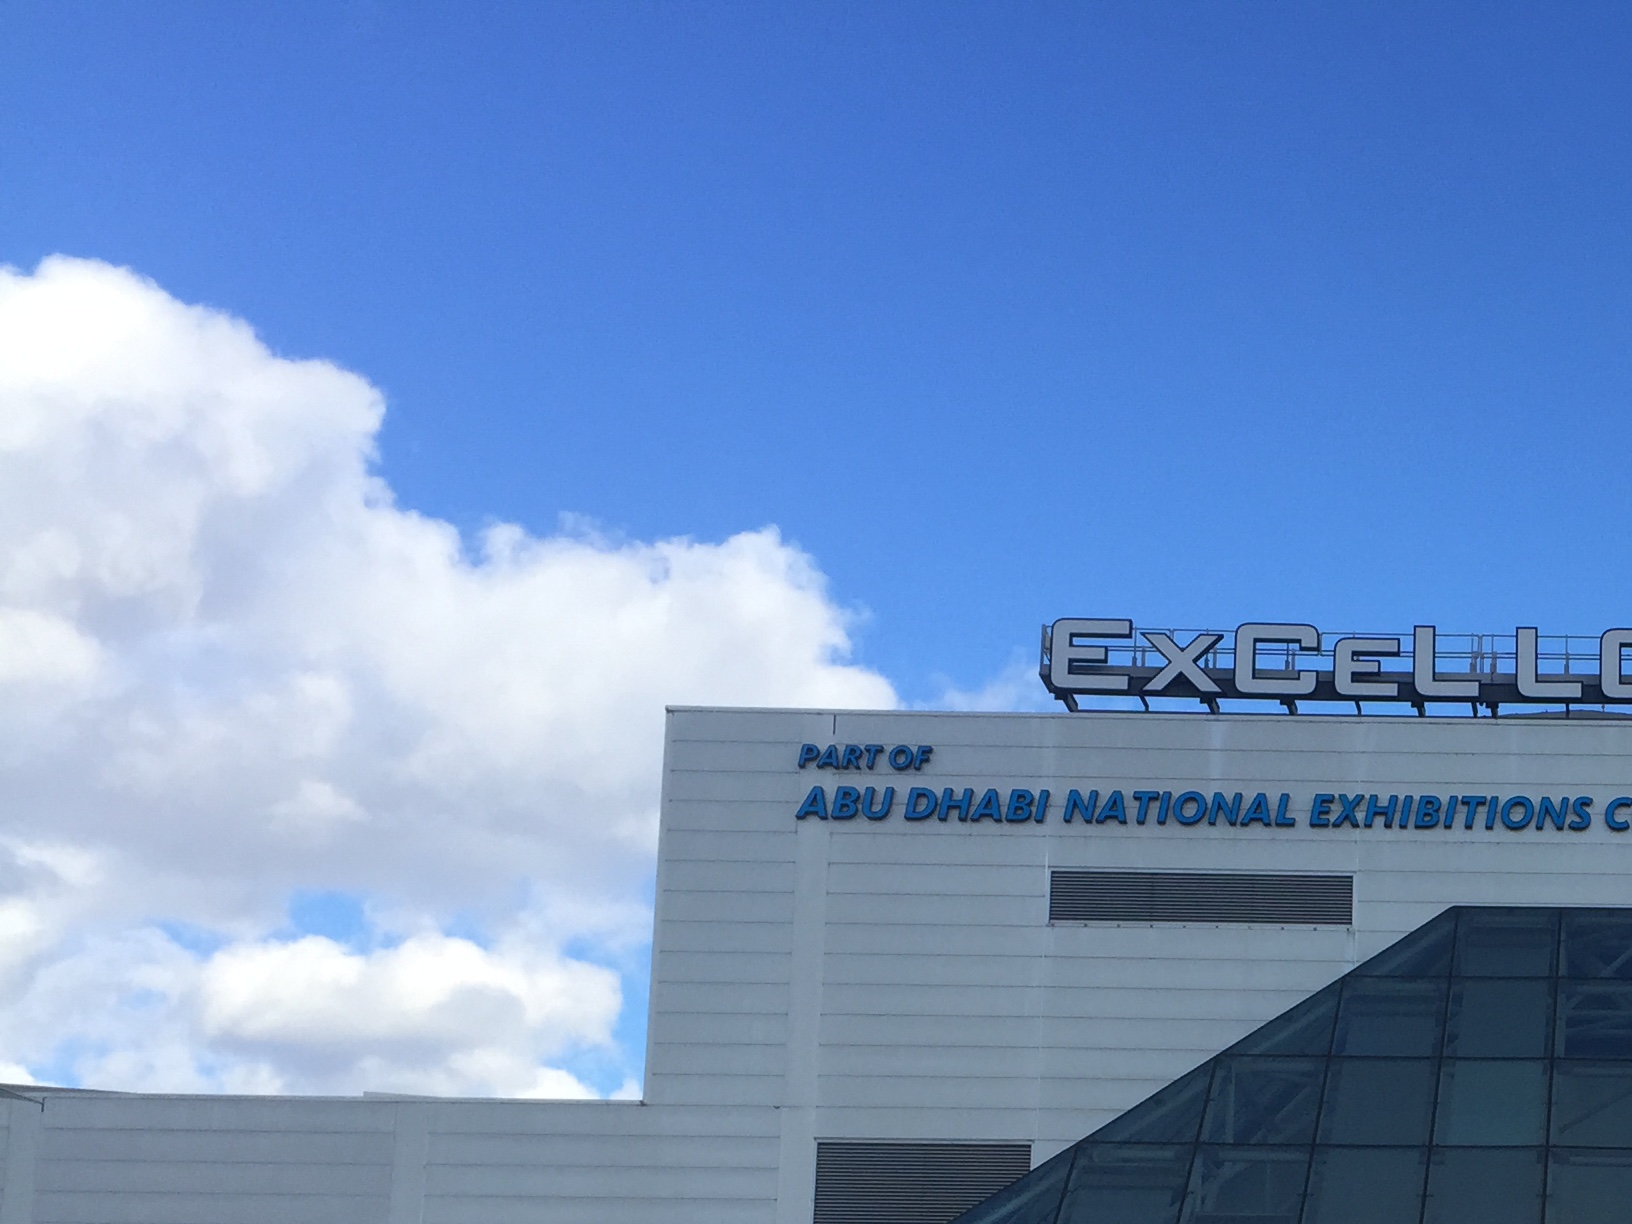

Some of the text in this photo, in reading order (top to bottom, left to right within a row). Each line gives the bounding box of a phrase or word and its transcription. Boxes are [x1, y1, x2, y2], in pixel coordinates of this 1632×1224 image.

[798, 744, 933, 771] PART OF
[795, 785, 895, 820] ABU
[904, 786, 1051, 823] DHABI
[1063, 790, 1296, 827] NATIONAL
[1309, 792, 1593, 831] EXHIBITIONS
